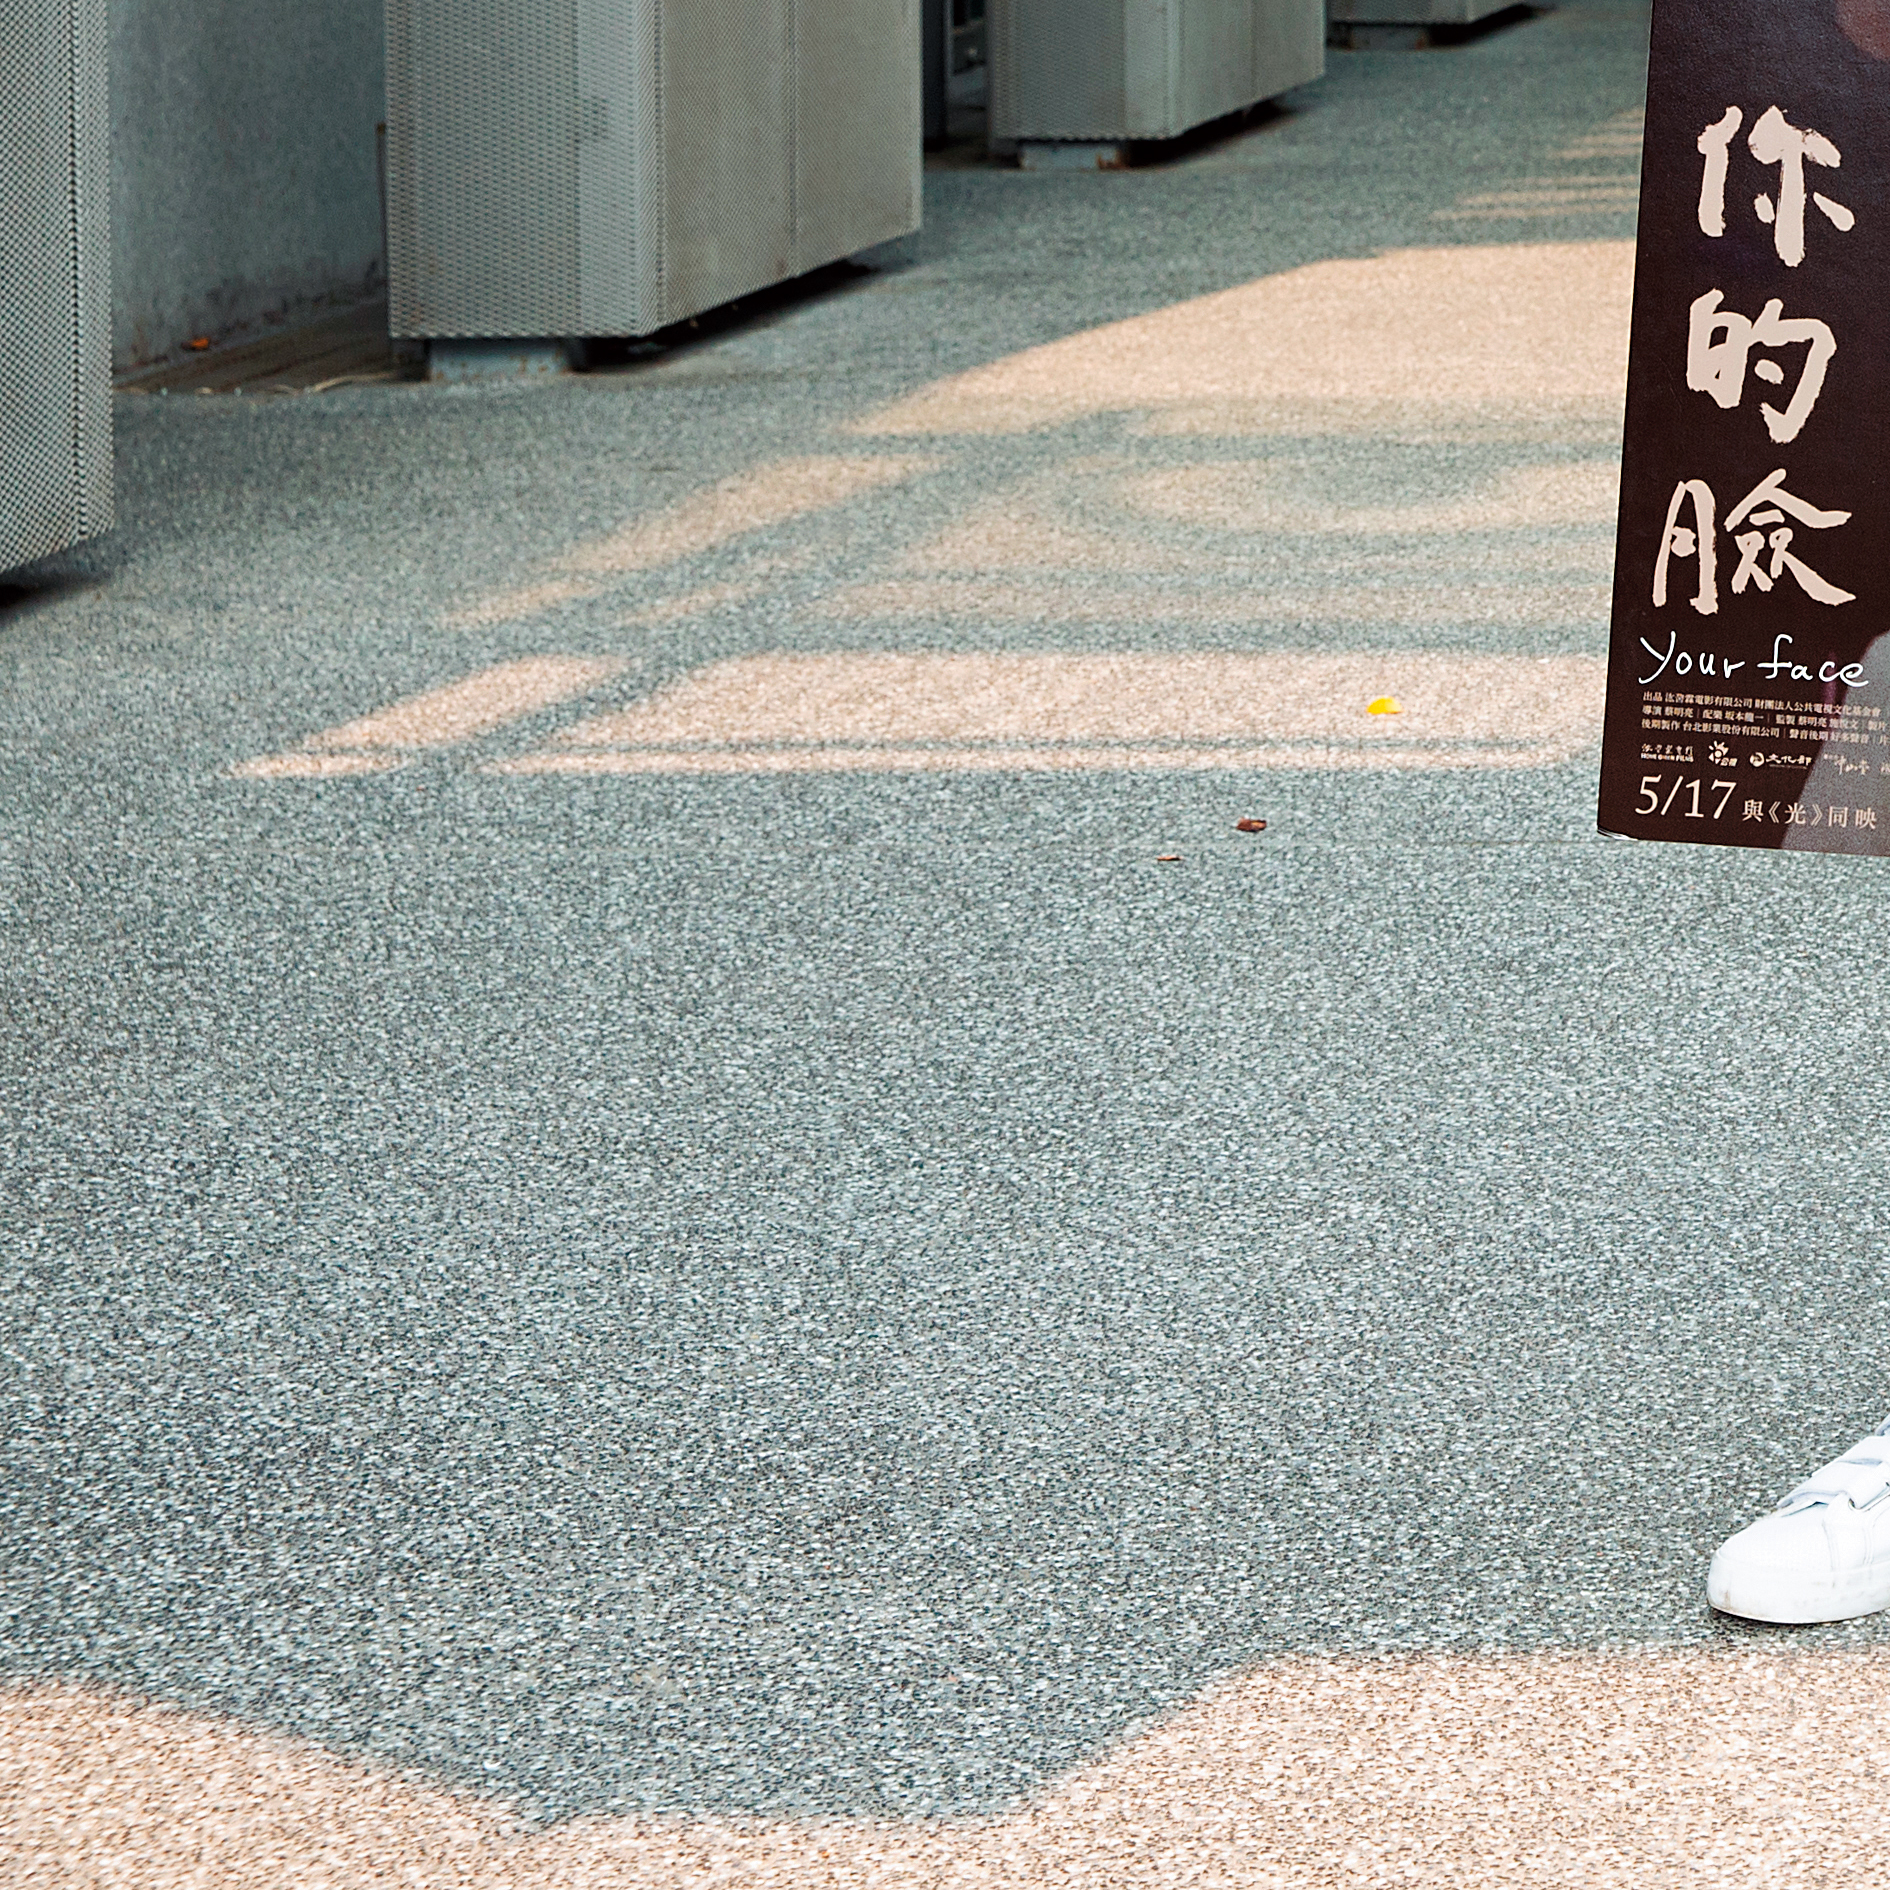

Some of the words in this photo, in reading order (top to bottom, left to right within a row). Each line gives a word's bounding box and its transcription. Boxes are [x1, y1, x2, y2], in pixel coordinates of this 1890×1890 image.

[1653, 106, 1853, 613] 你的臉
[1756, 631, 1871, 689] face
[1634, 772, 1737, 821] 5/17
